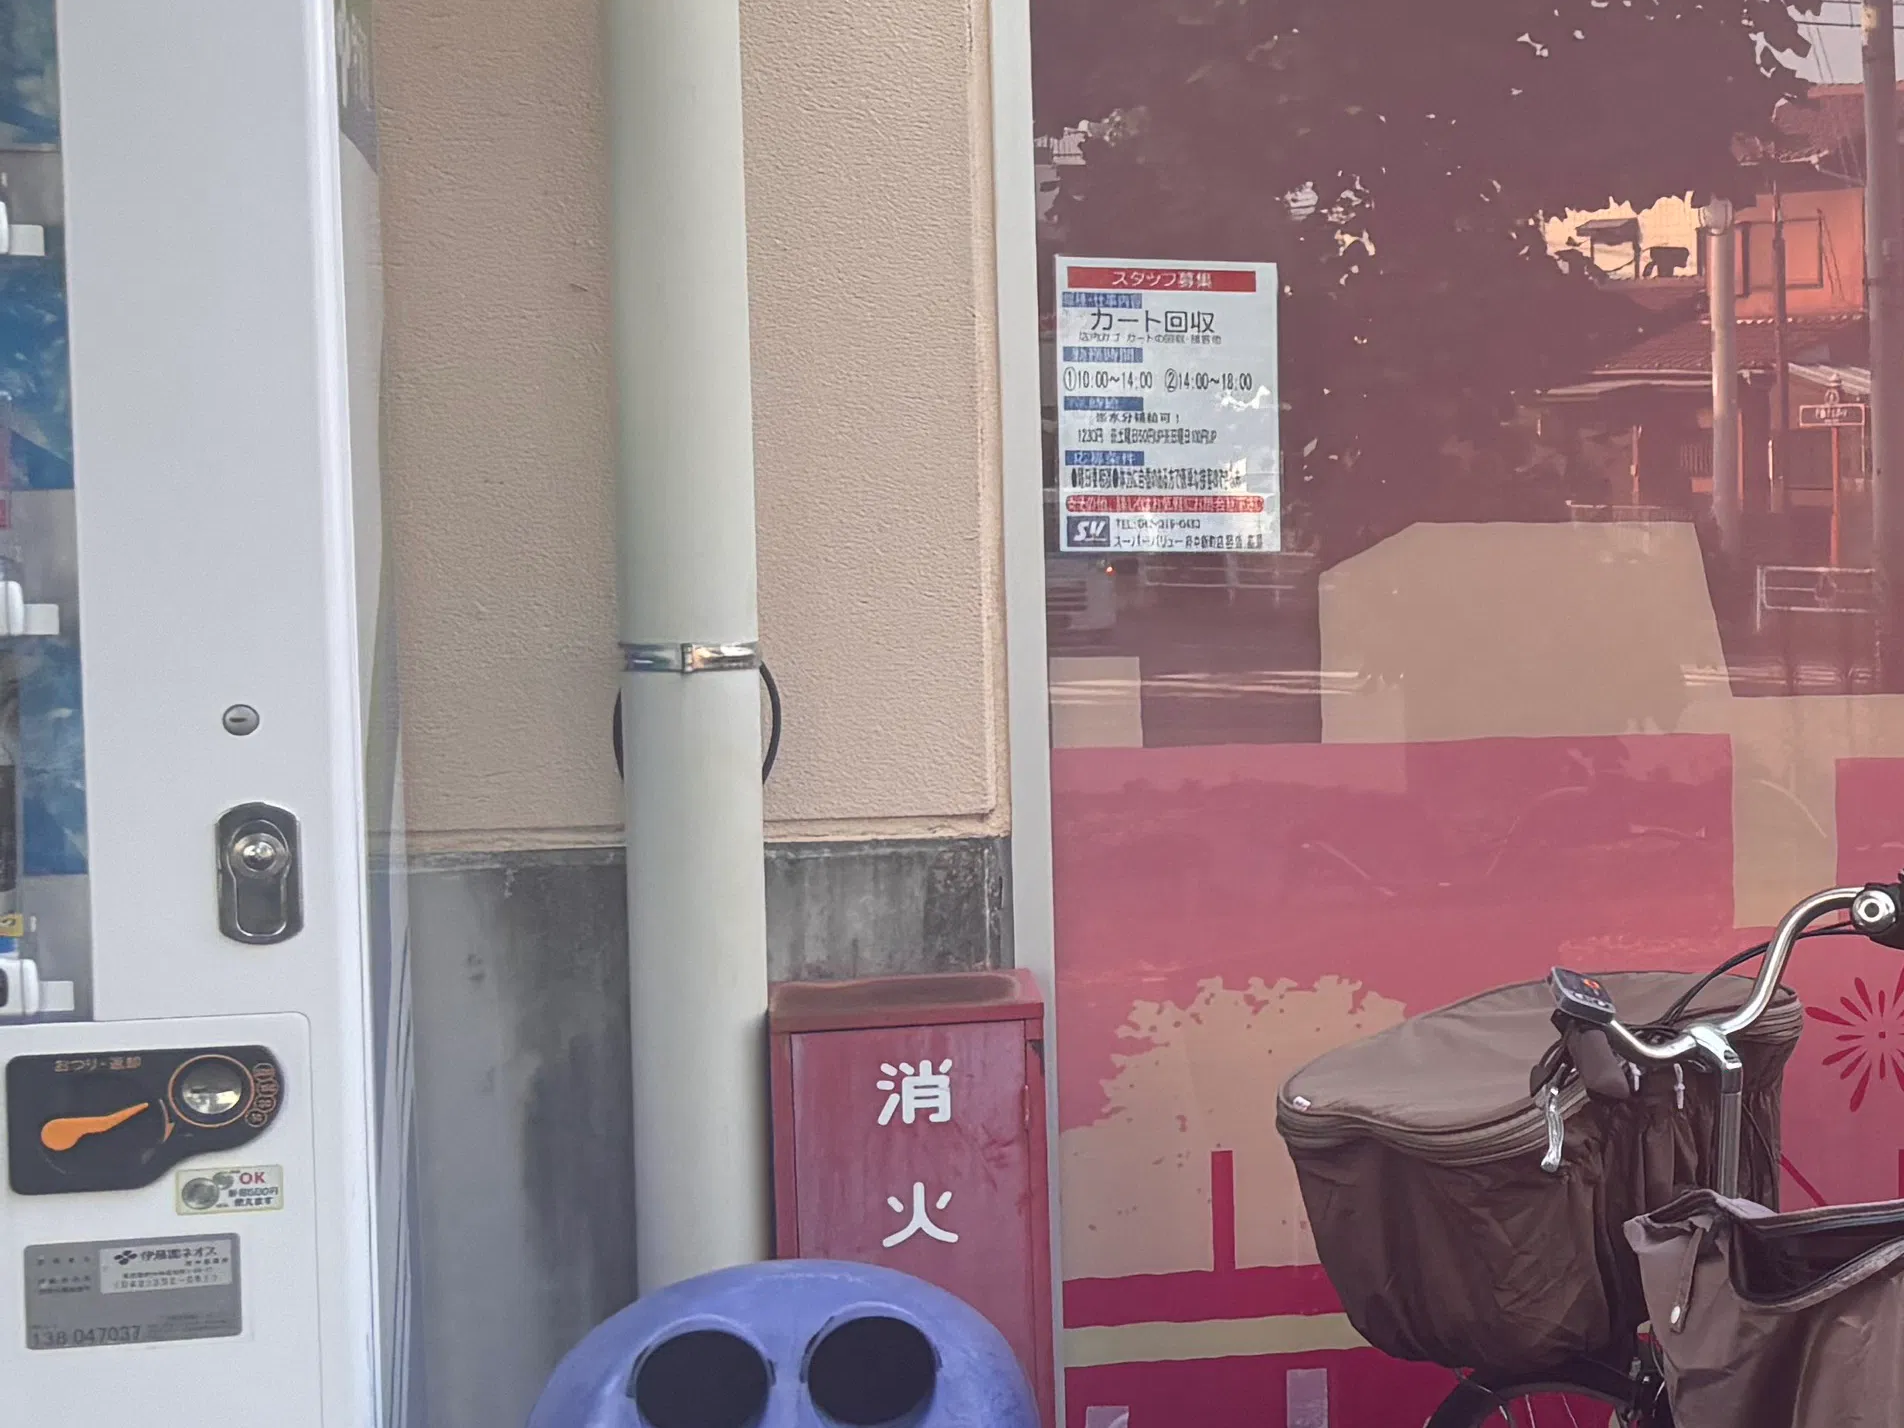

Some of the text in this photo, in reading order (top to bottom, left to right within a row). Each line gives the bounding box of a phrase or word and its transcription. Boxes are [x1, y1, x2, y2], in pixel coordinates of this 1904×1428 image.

[1111, 271, 1213, 289] スタッフ募集
[1090, 309, 1216, 334] カート回収
[876, 1057, 959, 1249] 消火
[239, 1171, 266, 1185] OK
